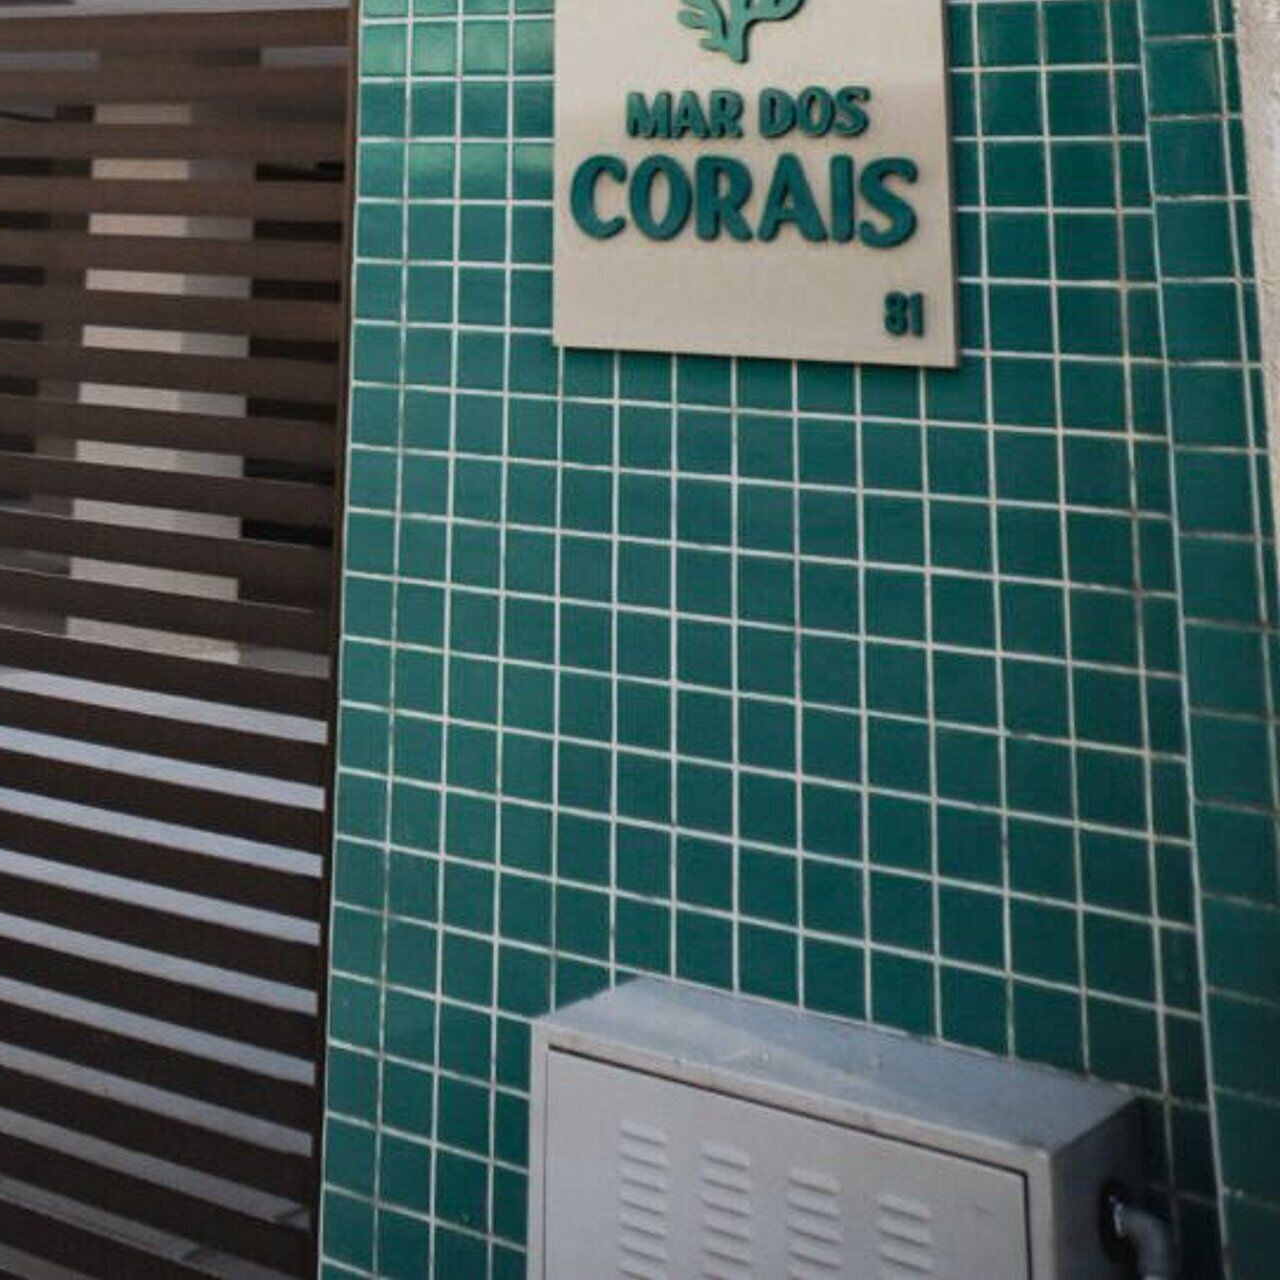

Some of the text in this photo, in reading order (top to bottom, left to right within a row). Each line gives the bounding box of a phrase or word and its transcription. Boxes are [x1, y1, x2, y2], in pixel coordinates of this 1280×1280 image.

[626, 86, 872, 138] MAR DOS
[570, 152, 919, 248] CORAIS
[884, 291, 924, 338] 81
